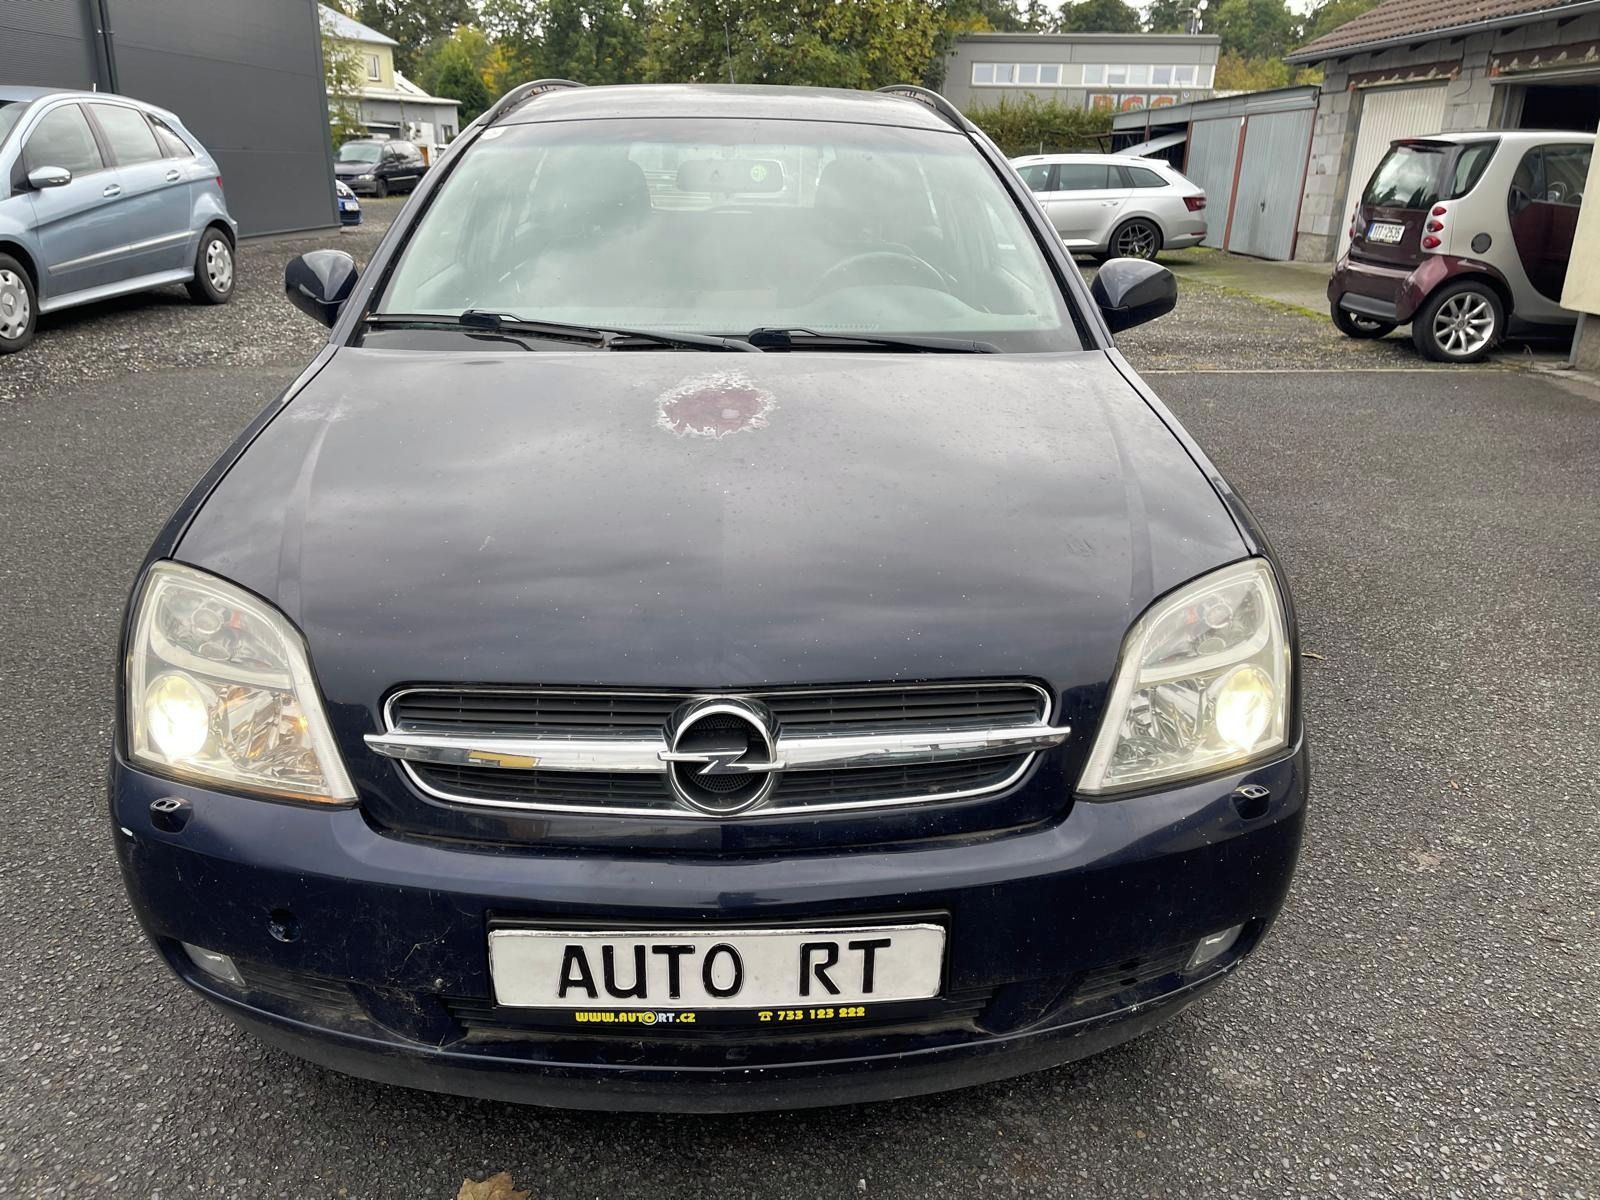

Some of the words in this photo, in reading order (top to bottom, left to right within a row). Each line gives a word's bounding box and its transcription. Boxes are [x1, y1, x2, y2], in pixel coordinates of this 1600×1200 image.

[558, 942, 744, 999] AUTO
[799, 938, 891, 997] RT
[777, 1010, 803, 1021] 733
[809, 1008, 834, 1020] 123
[839, 1006, 865, 1018] 222
